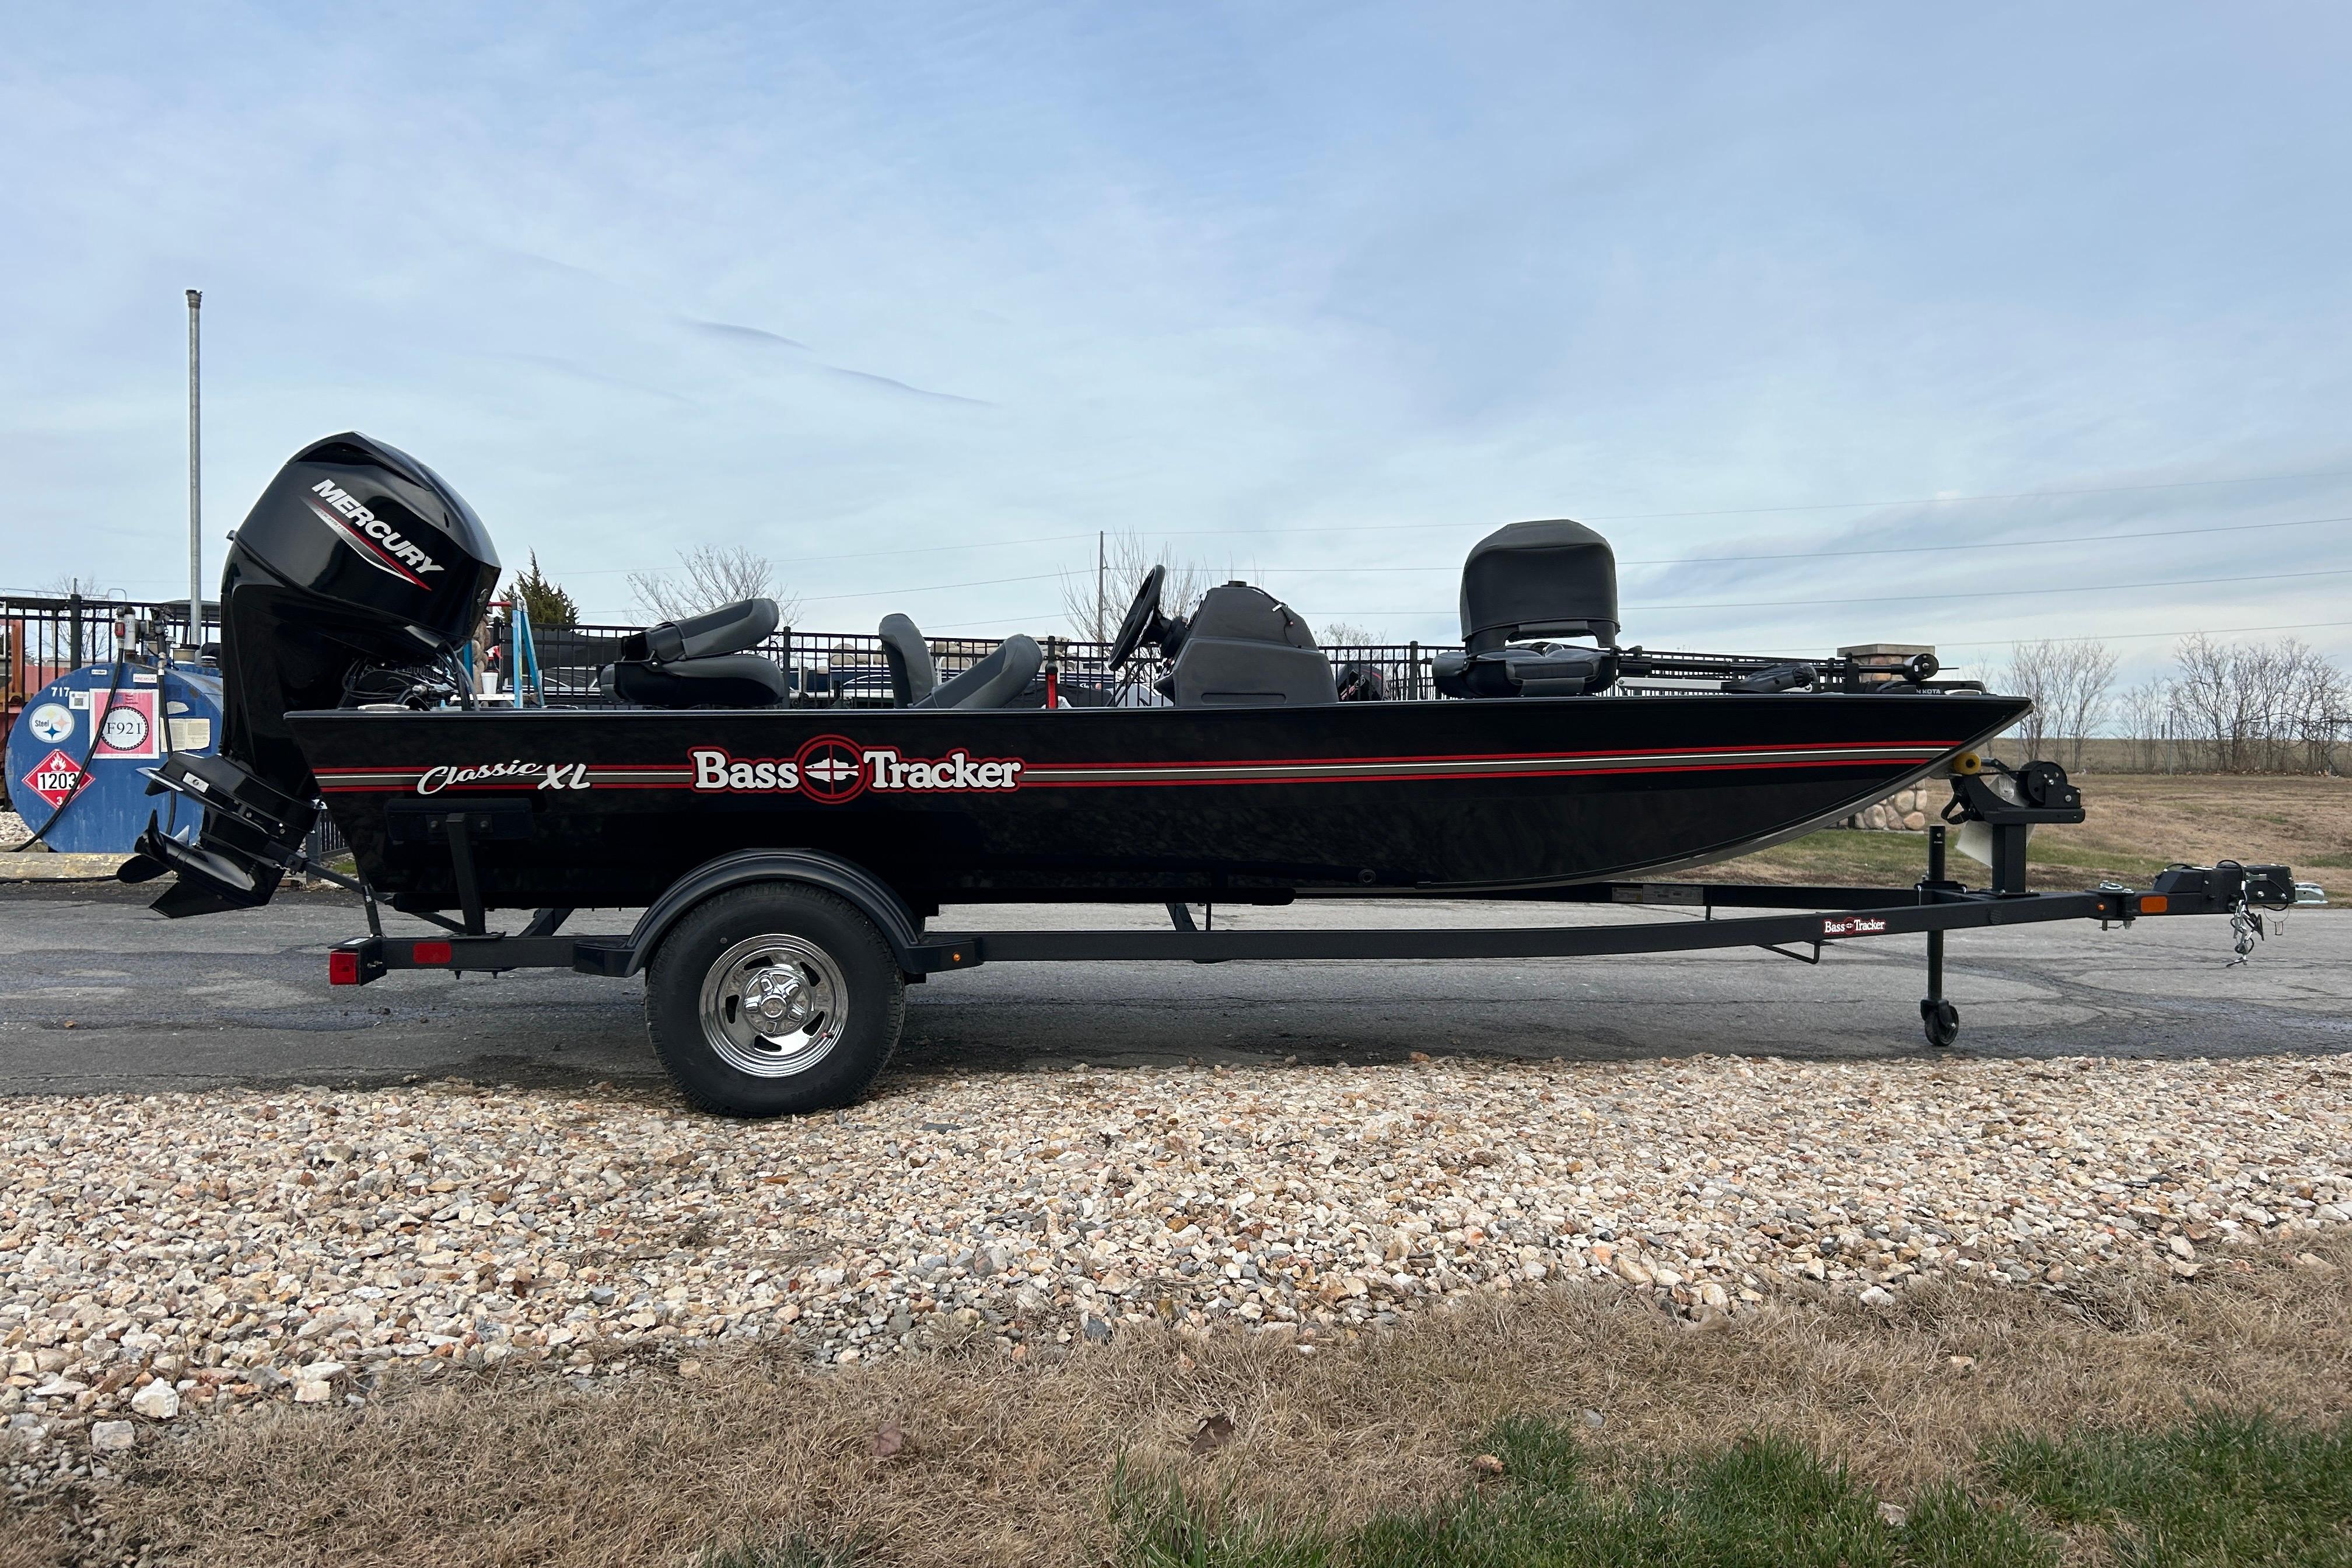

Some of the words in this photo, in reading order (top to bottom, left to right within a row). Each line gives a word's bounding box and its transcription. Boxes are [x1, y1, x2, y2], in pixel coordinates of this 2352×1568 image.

[312, 479, 444, 574] MERCURY
[51, 687, 70, 697] 717
[35, 719, 50, 727] Steel
[106, 722, 141, 734] F921
[693, 751, 799, 789] Bass
[863, 750, 1023, 788] Tracker
[40, 772, 77, 789] 1203
[416, 760, 543, 795] Classic
[537, 763, 591, 790] XL
[56, 796, 63, 806] 3
[1824, 921, 1846, 933] Bass
[1853, 919, 1885, 931] Tracker
